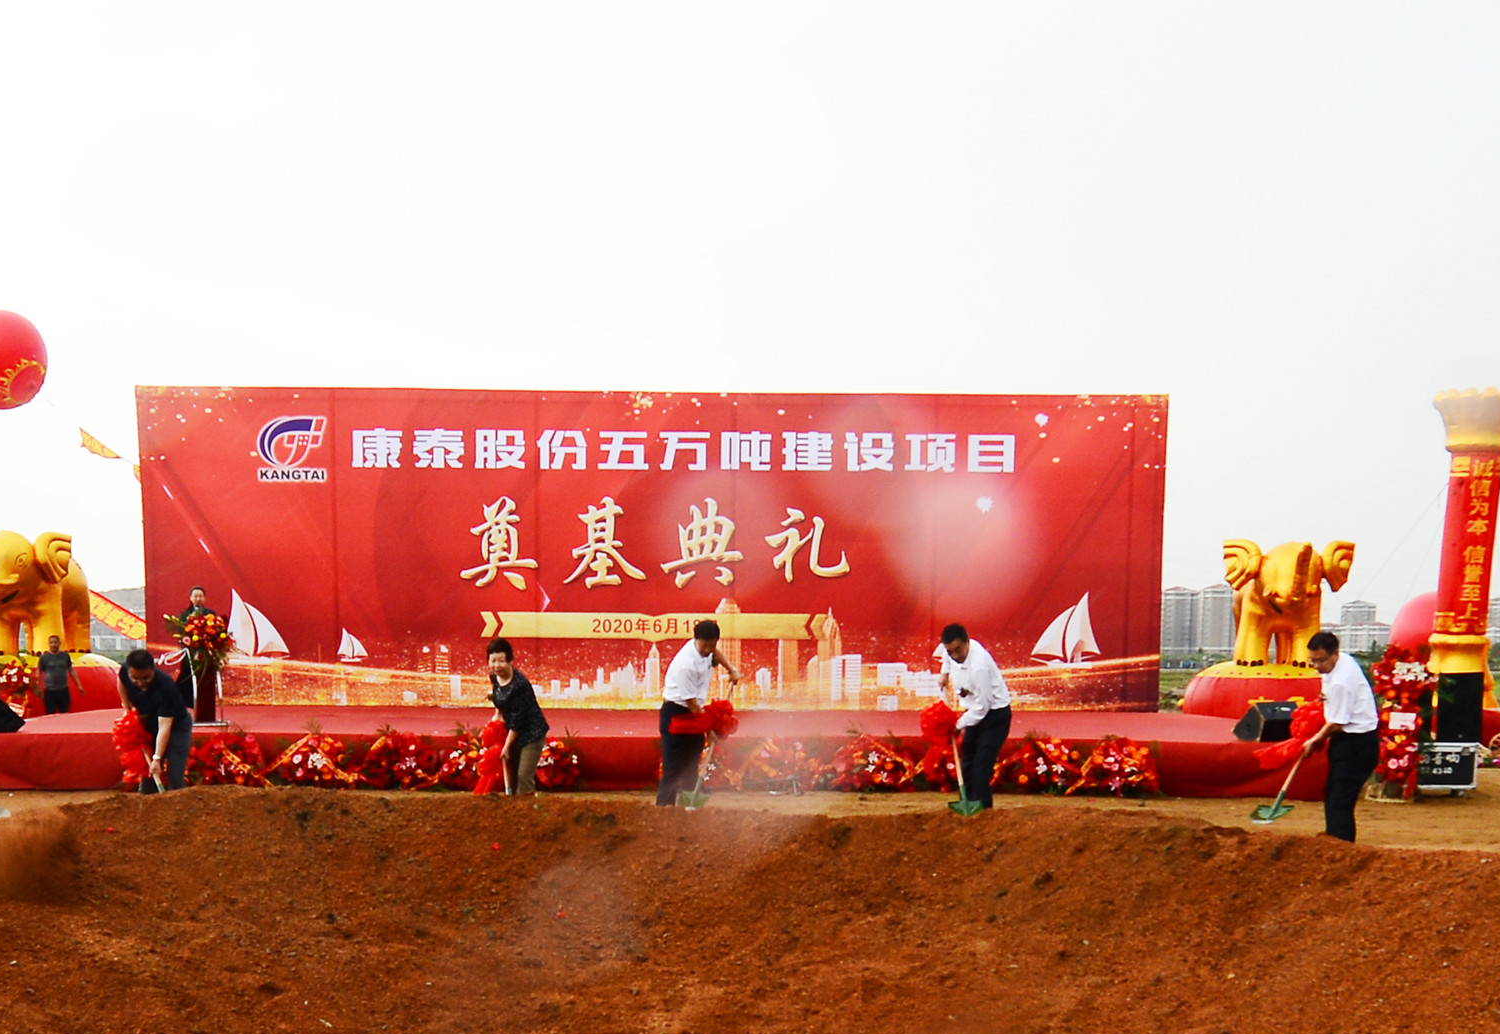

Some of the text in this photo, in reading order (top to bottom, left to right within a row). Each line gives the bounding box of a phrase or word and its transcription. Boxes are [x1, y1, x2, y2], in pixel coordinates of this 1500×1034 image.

[352, 427, 1016, 472] 康泰股份五万吨建设项目
[258, 468, 326, 481] KANGTAI
[459, 495, 851, 590] 奠基典礼
[1457, 459, 1494, 619] 诚信为本 信誉至上
[592, 617, 718, 635] 2020年6月1
